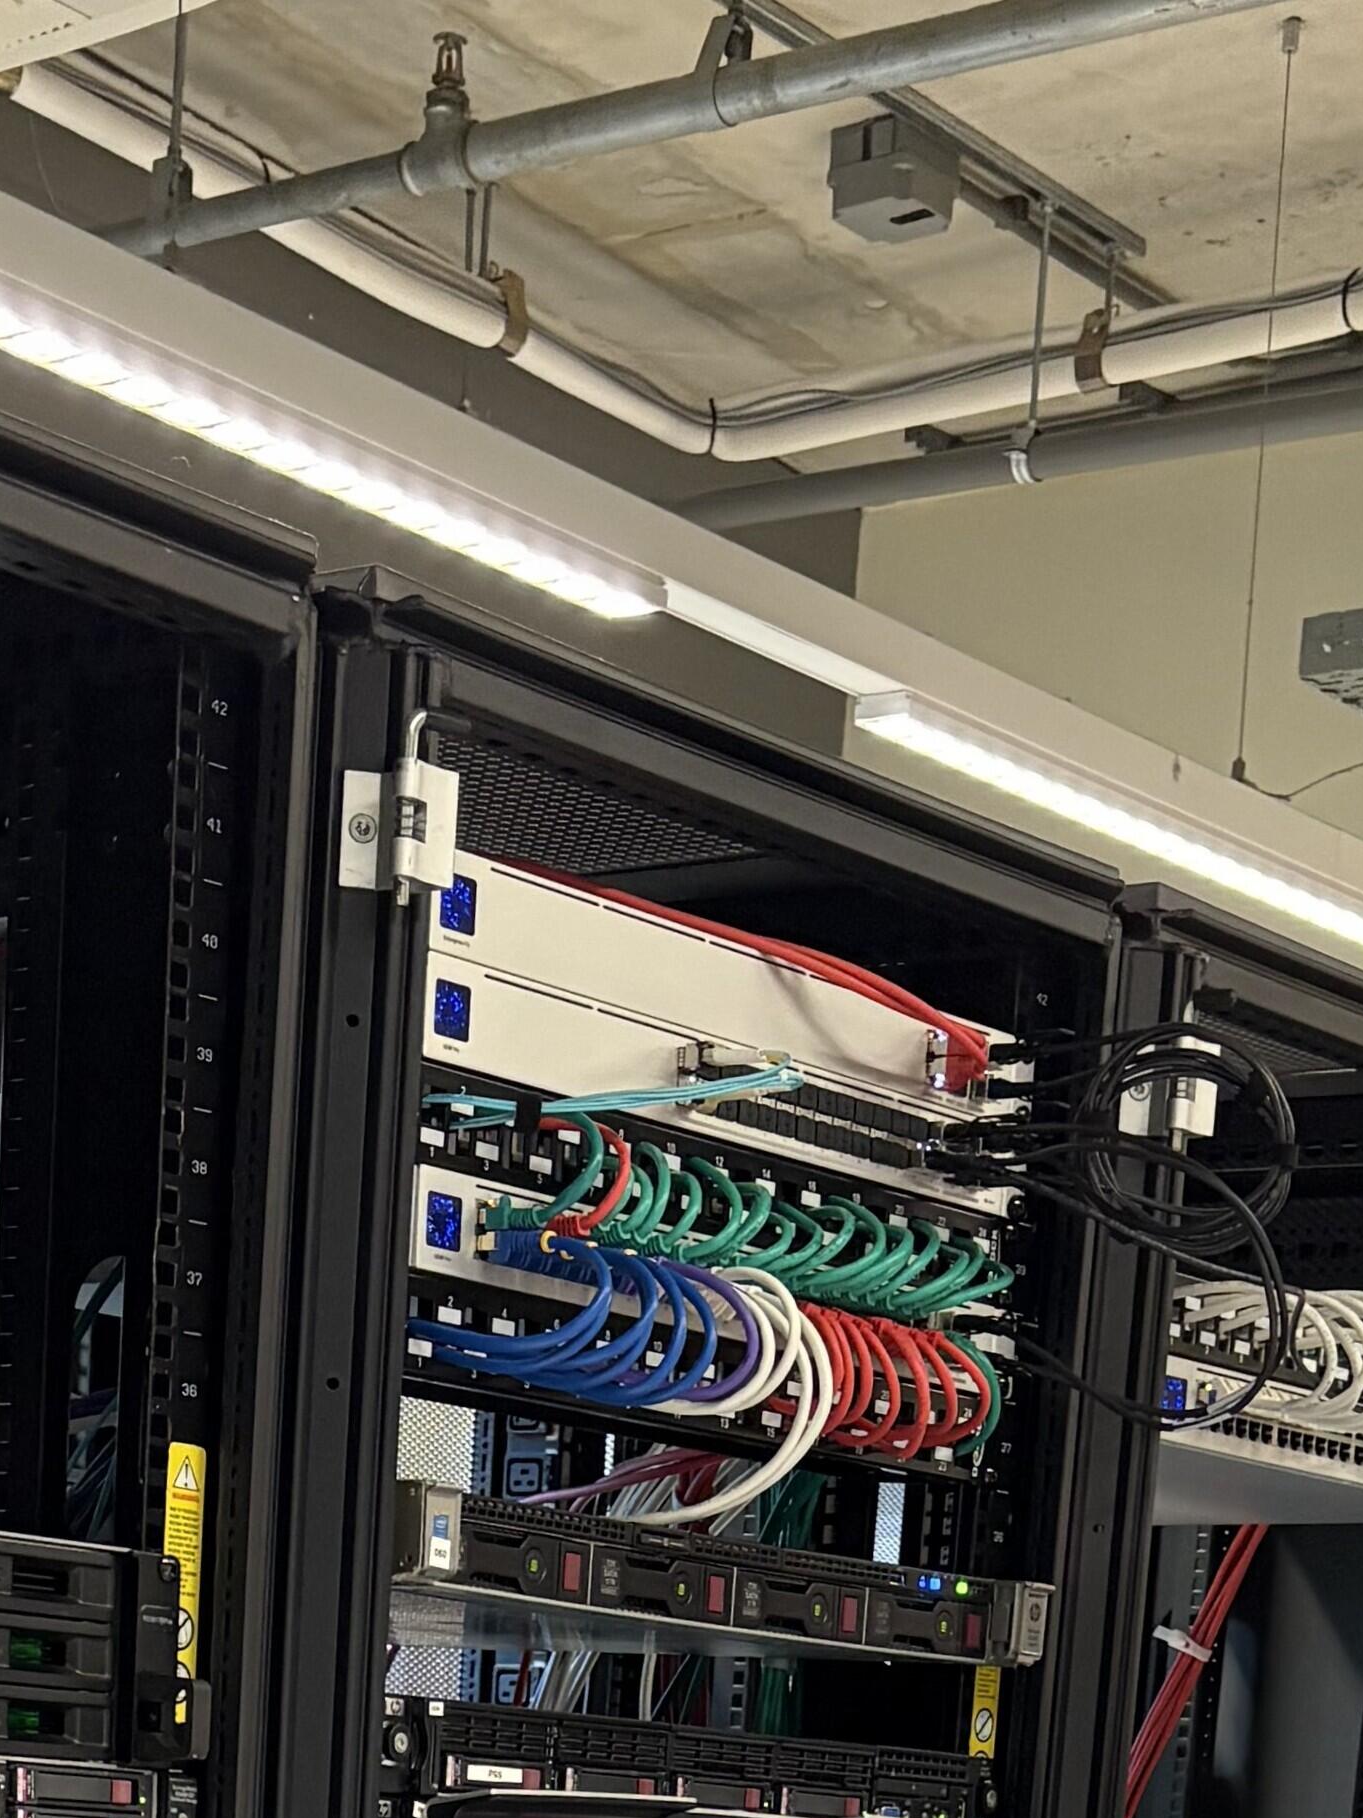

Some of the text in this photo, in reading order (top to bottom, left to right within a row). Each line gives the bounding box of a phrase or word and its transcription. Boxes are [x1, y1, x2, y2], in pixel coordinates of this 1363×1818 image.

[211, 698, 229, 718] 42
[206, 816, 222, 834] 41
[202, 932, 218, 950] 40
[196, 1046, 214, 1062] 39
[191, 1160, 208, 1176] 38
[186, 1270, 203, 1286] 37
